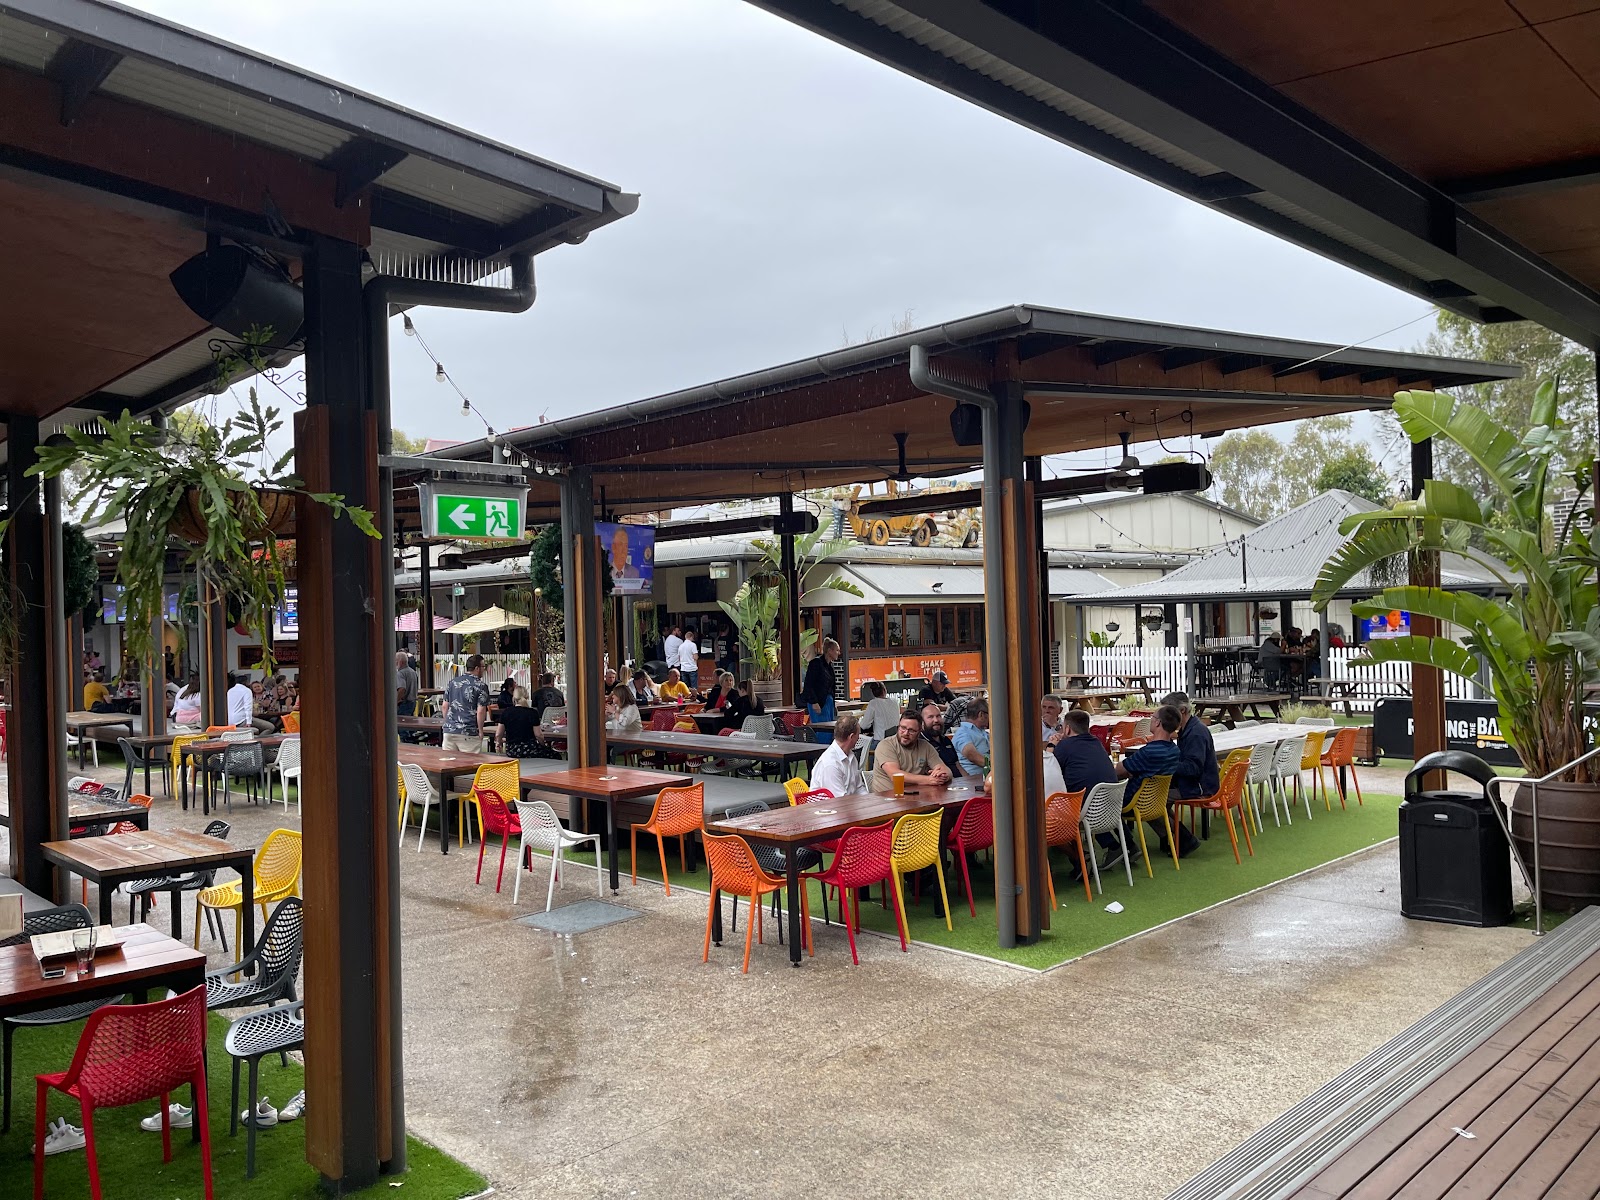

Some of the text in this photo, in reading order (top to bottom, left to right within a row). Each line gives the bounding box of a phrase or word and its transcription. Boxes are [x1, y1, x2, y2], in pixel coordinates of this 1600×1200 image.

[920, 659, 944, 669] SHAKE
[923, 667, 930, 675] IT
[1469, 722, 1477, 738] THE
